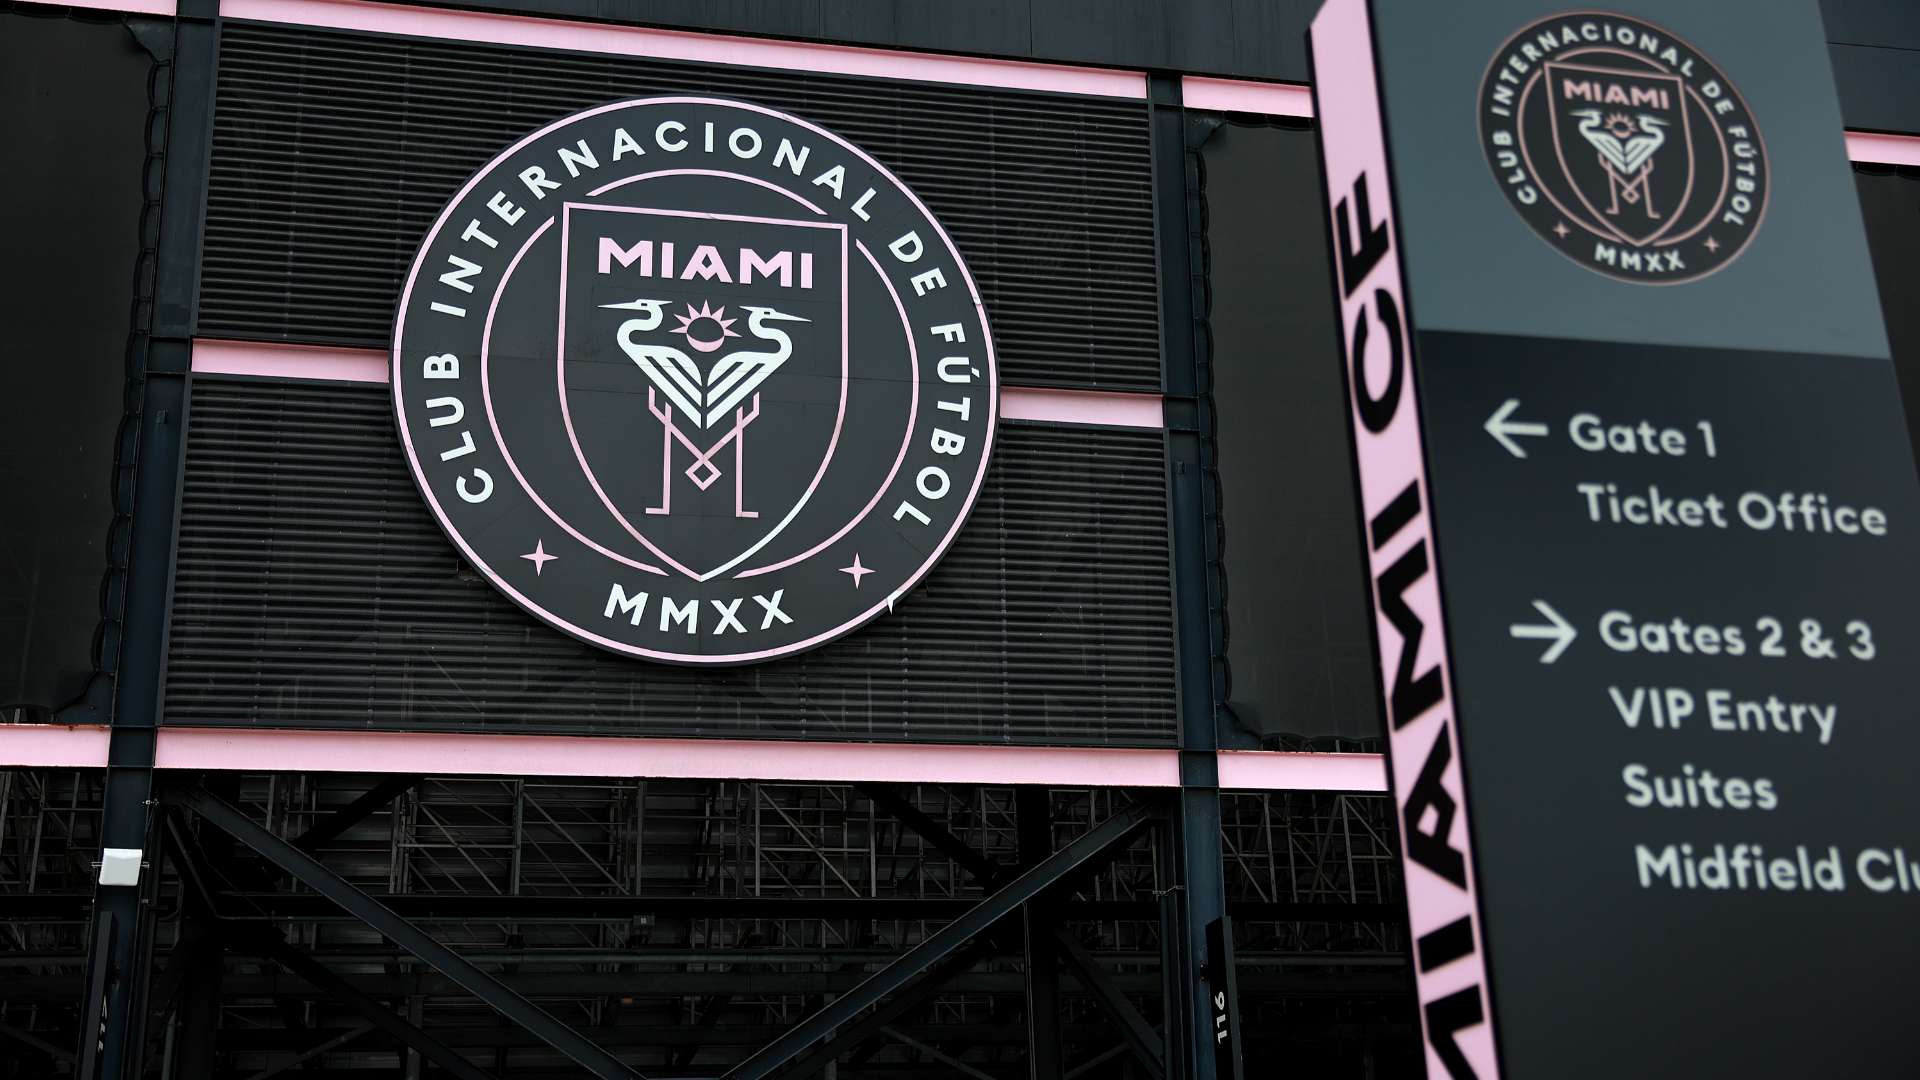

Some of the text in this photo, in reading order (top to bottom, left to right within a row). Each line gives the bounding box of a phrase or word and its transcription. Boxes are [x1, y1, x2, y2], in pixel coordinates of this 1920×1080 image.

[1563, 79, 1670, 110] MIAMI
[1490, 22, 1760, 227] CLUB INTERNACIONAL DE FÚTBOL
[598, 236, 815, 290] MIAMI
[1594, 242, 1687, 274] MMXX
[422, 119, 979, 528] CLUB INTERNACIONAL DE FÚTBOL
[1336, 170, 1403, 434] CF
[1567, 412, 1718, 459] Gate 1
[1577, 481, 1889, 537] Ticket Office
[602, 582, 795, 636] MMXX
[1598, 610, 1877, 661] Gates 2 & 3
[1608, 686, 1838, 745] VIP Entry
[1622, 763, 1779, 811] Suites
[1634, 843, 1846, 891] Midfield
[1214, 991, 1228, 1044] 116
